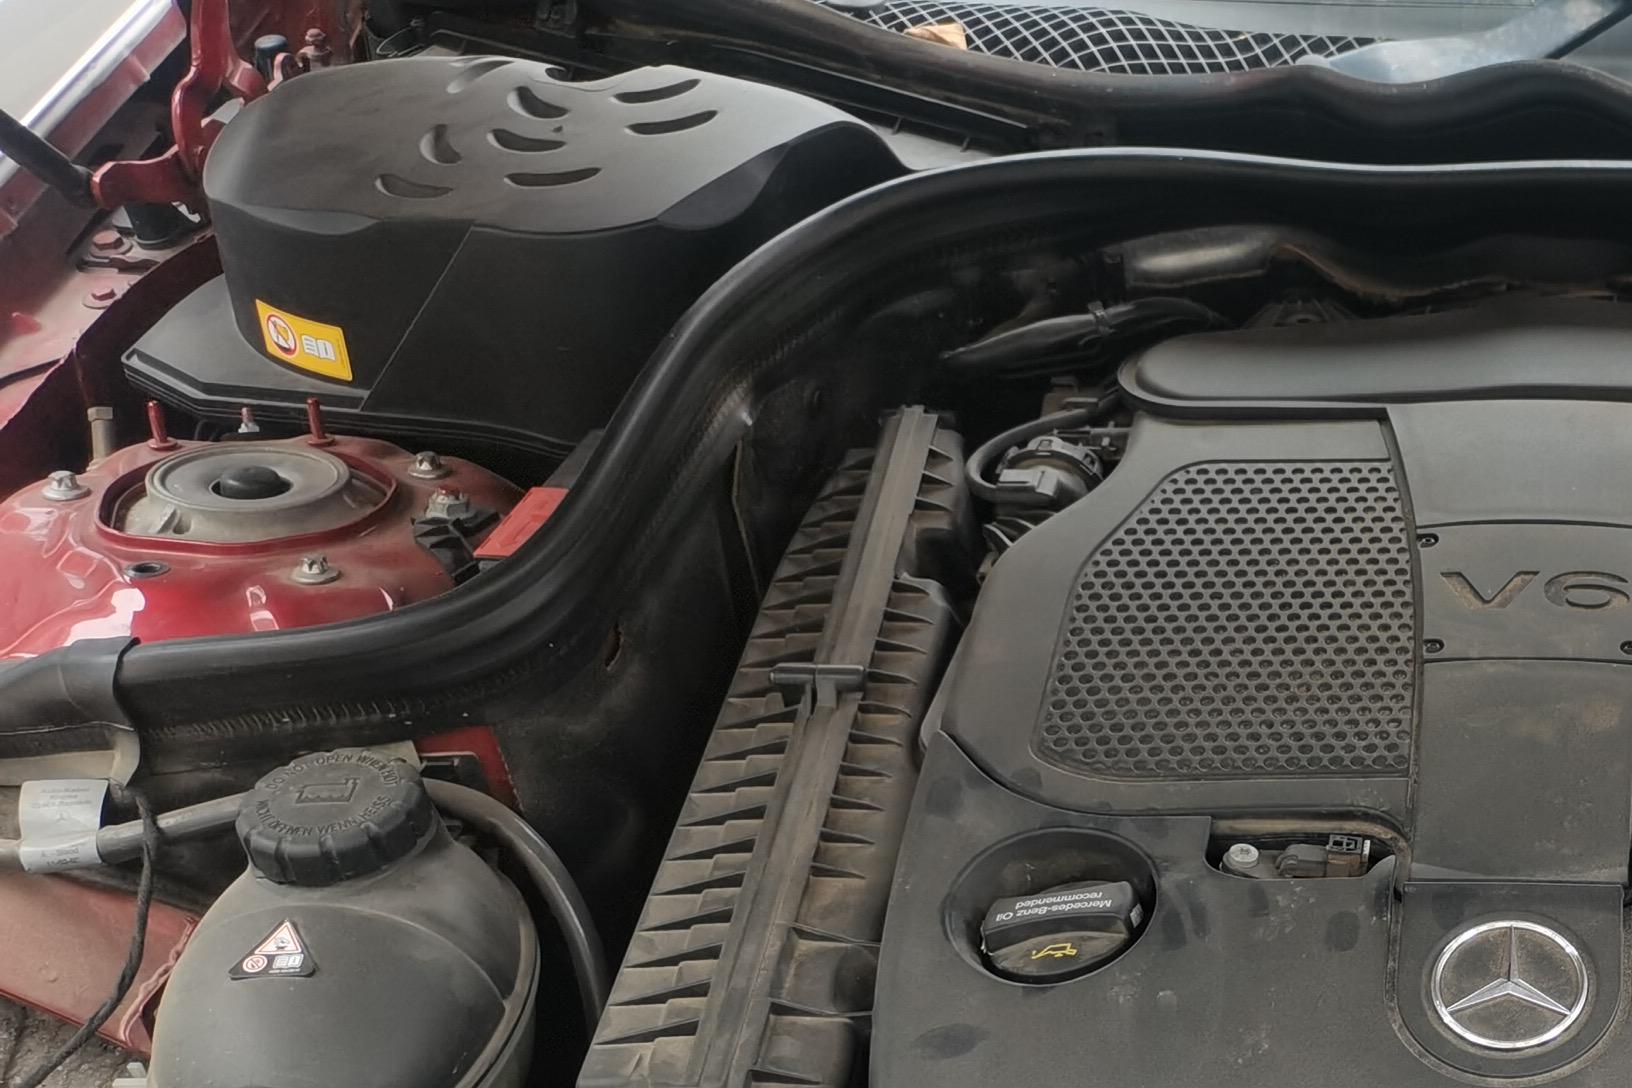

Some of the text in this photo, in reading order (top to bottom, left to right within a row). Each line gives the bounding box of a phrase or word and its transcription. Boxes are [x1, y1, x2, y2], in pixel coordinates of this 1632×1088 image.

[1439, 570, 1631, 610] V6
[995, 899, 1113, 922] Mercedes-Benz Oil
[1014, 891, 1103, 910] recommended
